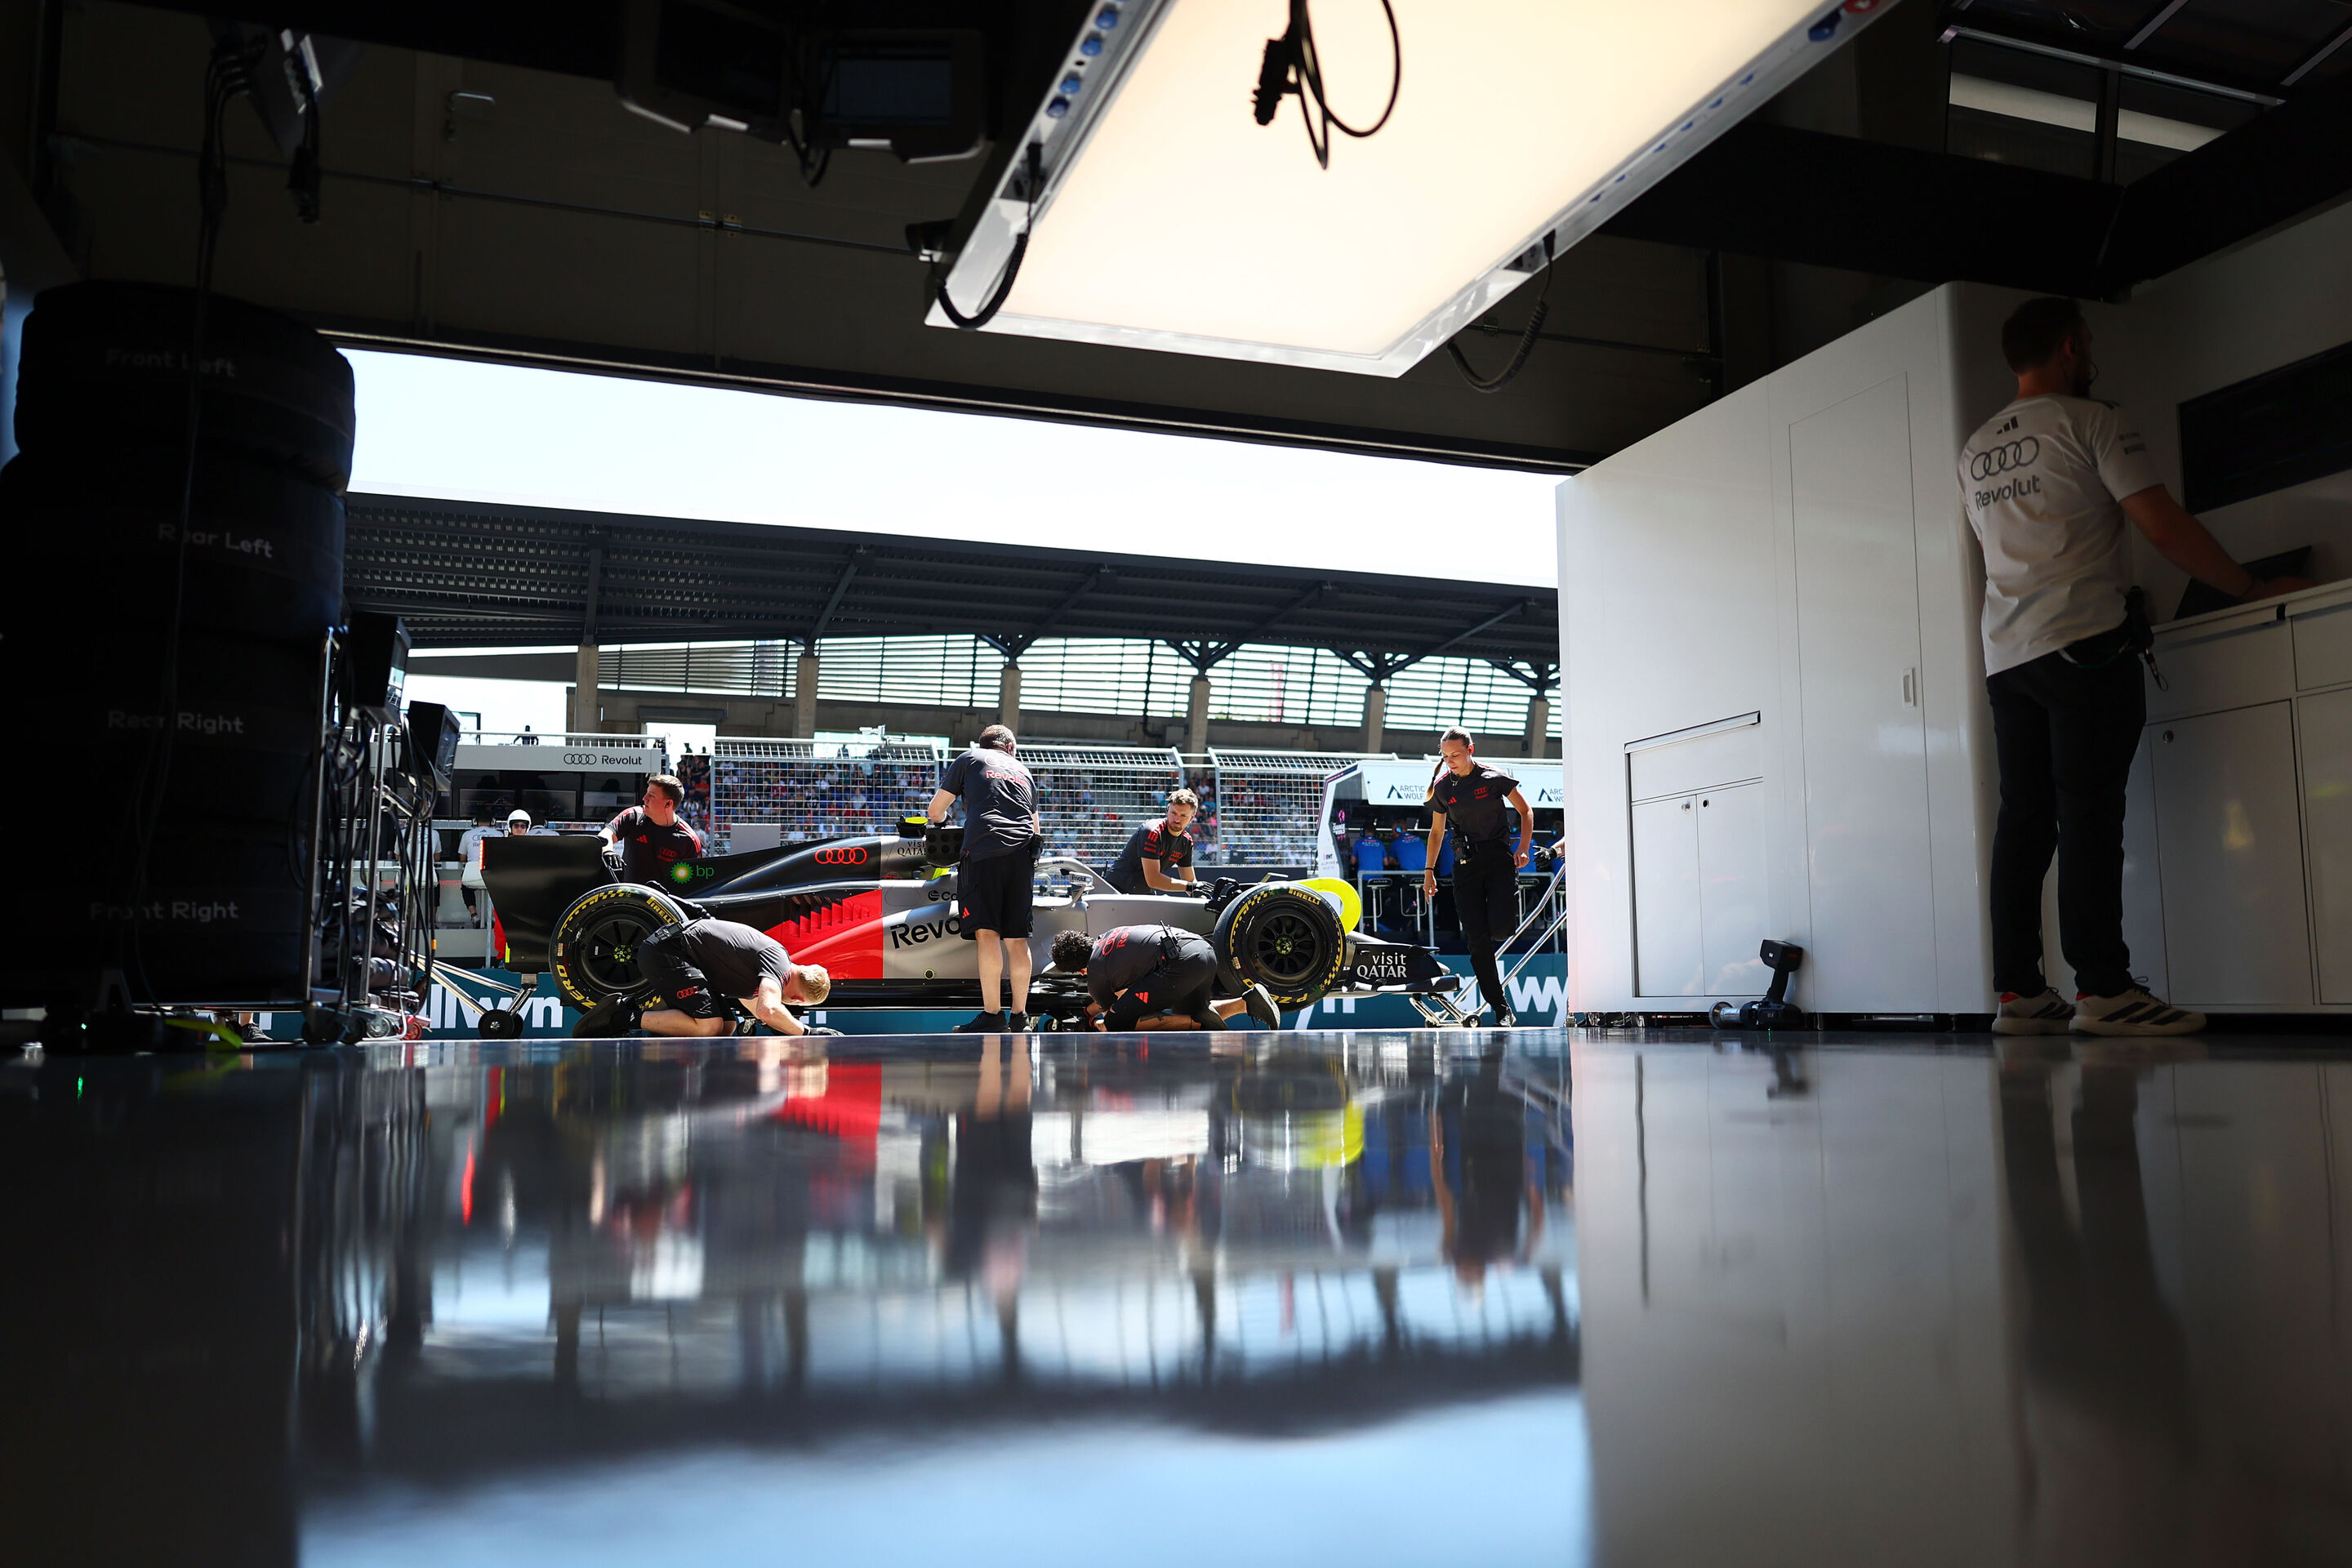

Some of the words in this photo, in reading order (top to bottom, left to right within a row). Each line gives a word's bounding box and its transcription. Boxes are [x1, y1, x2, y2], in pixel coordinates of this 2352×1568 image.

[1975, 474, 2041, 511] Revolut
[225, 531, 274, 559] Left
[176, 712, 244, 735] Right
[601, 755, 642, 765] Revolut
[696, 865, 715, 880] bp
[1289, 888, 1321, 906] PIRELLI
[172, 901, 239, 923] Right
[646, 896, 679, 924] PIRELL
[1372, 951, 1407, 965] visit
[1356, 964, 1407, 979] QATAR
